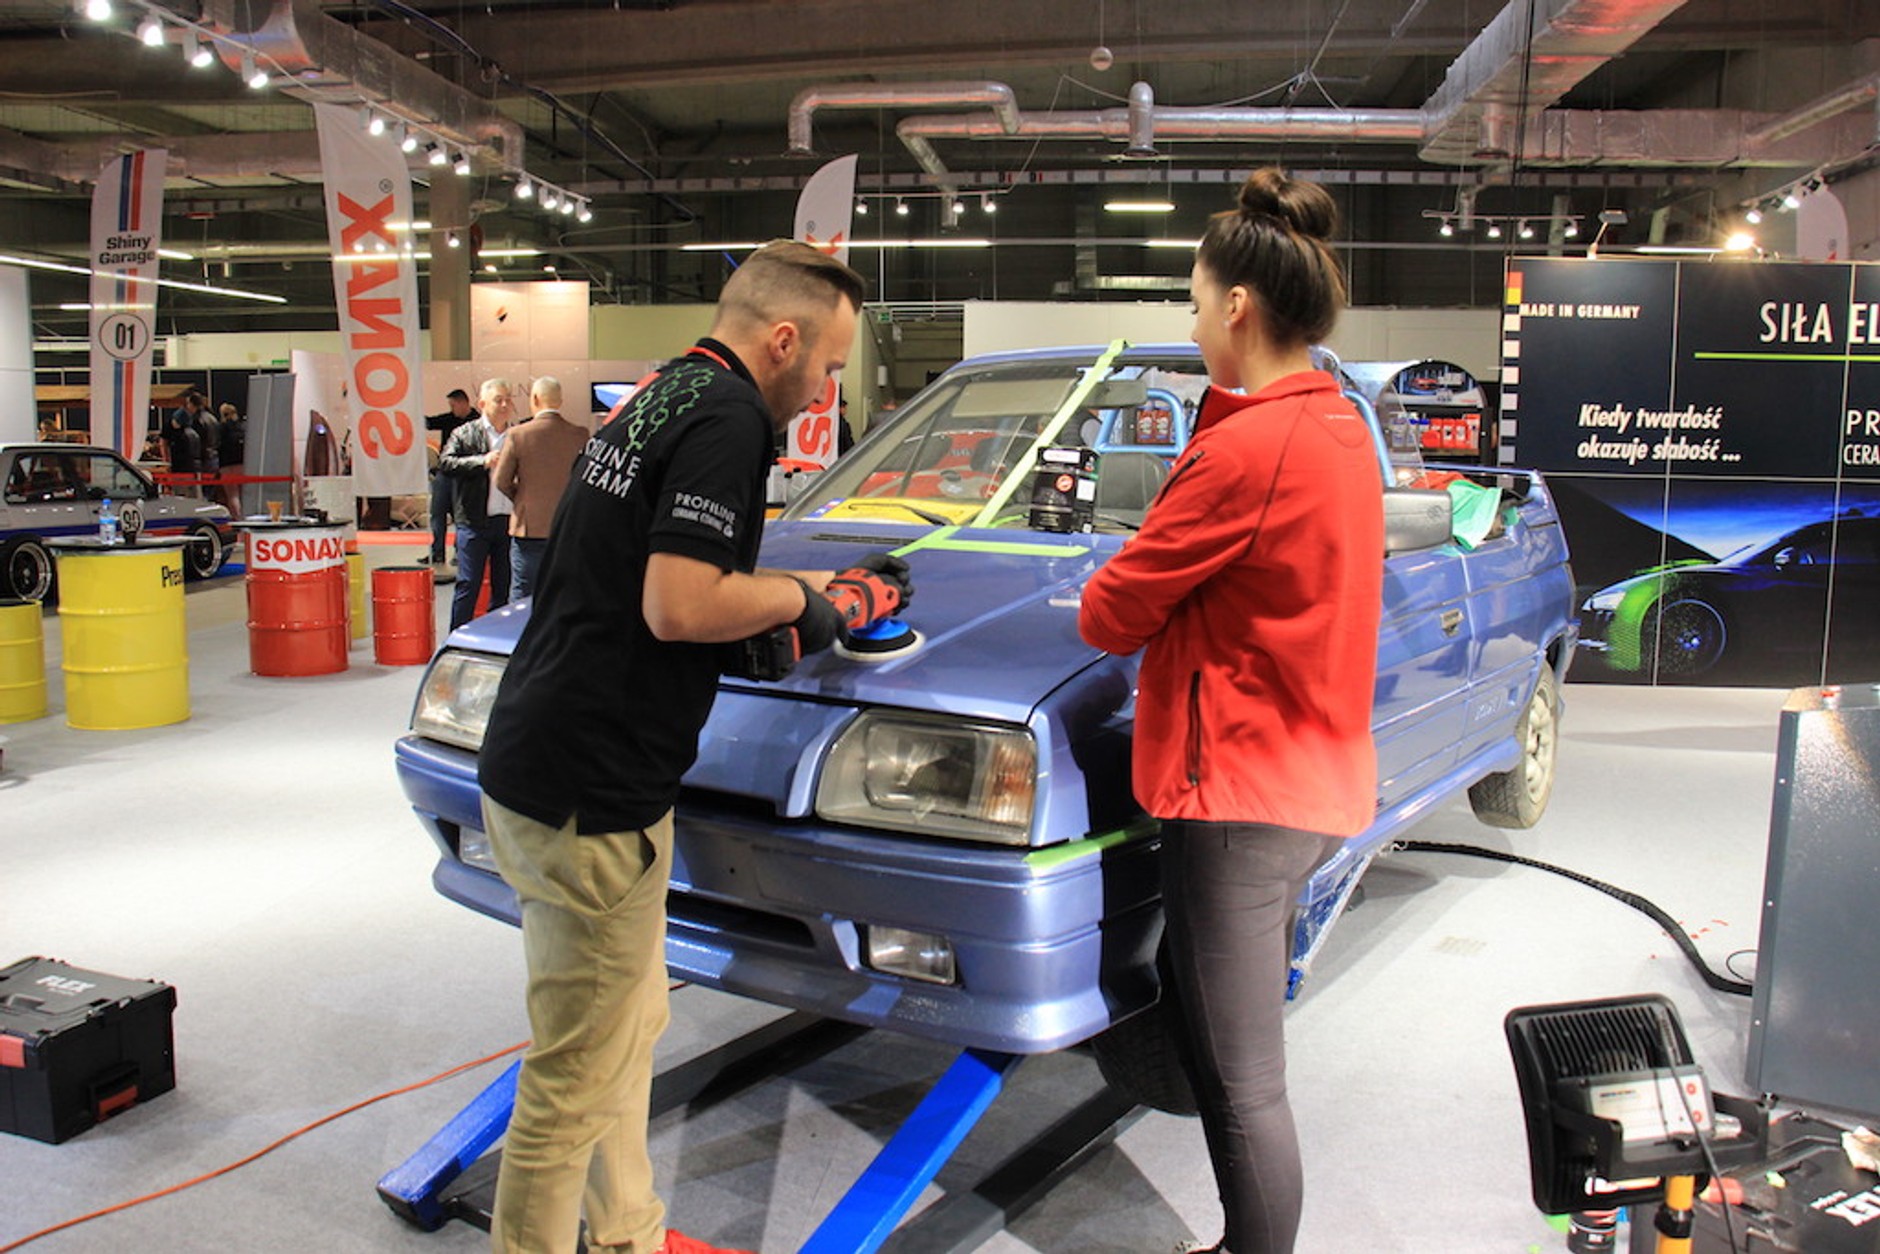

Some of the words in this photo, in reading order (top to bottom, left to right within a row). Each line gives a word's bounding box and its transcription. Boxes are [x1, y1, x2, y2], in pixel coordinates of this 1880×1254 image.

[106, 235, 152, 250] Shiny
[99, 250, 156, 265] Garage
[1519, 303, 1554, 317] MADE
[1559, 304, 1573, 317] IN
[1577, 304, 1641, 319] GERMANY
[1760, 301, 1833, 343] SIŁA
[1849, 302, 1880, 343] EL
[115, 323, 135, 350] 01
[1578, 403, 1632, 434] Kiedy
[1635, 404, 1723, 429] twardość
[1846, 410, 1880, 435] PR
[1577, 434, 1649, 466] okazuje
[1652, 436, 1721, 461] słabość
[582, 461, 633, 498] TEAM
[255, 535, 343, 563] SONAX
[36, 975, 96, 993] FLEX
